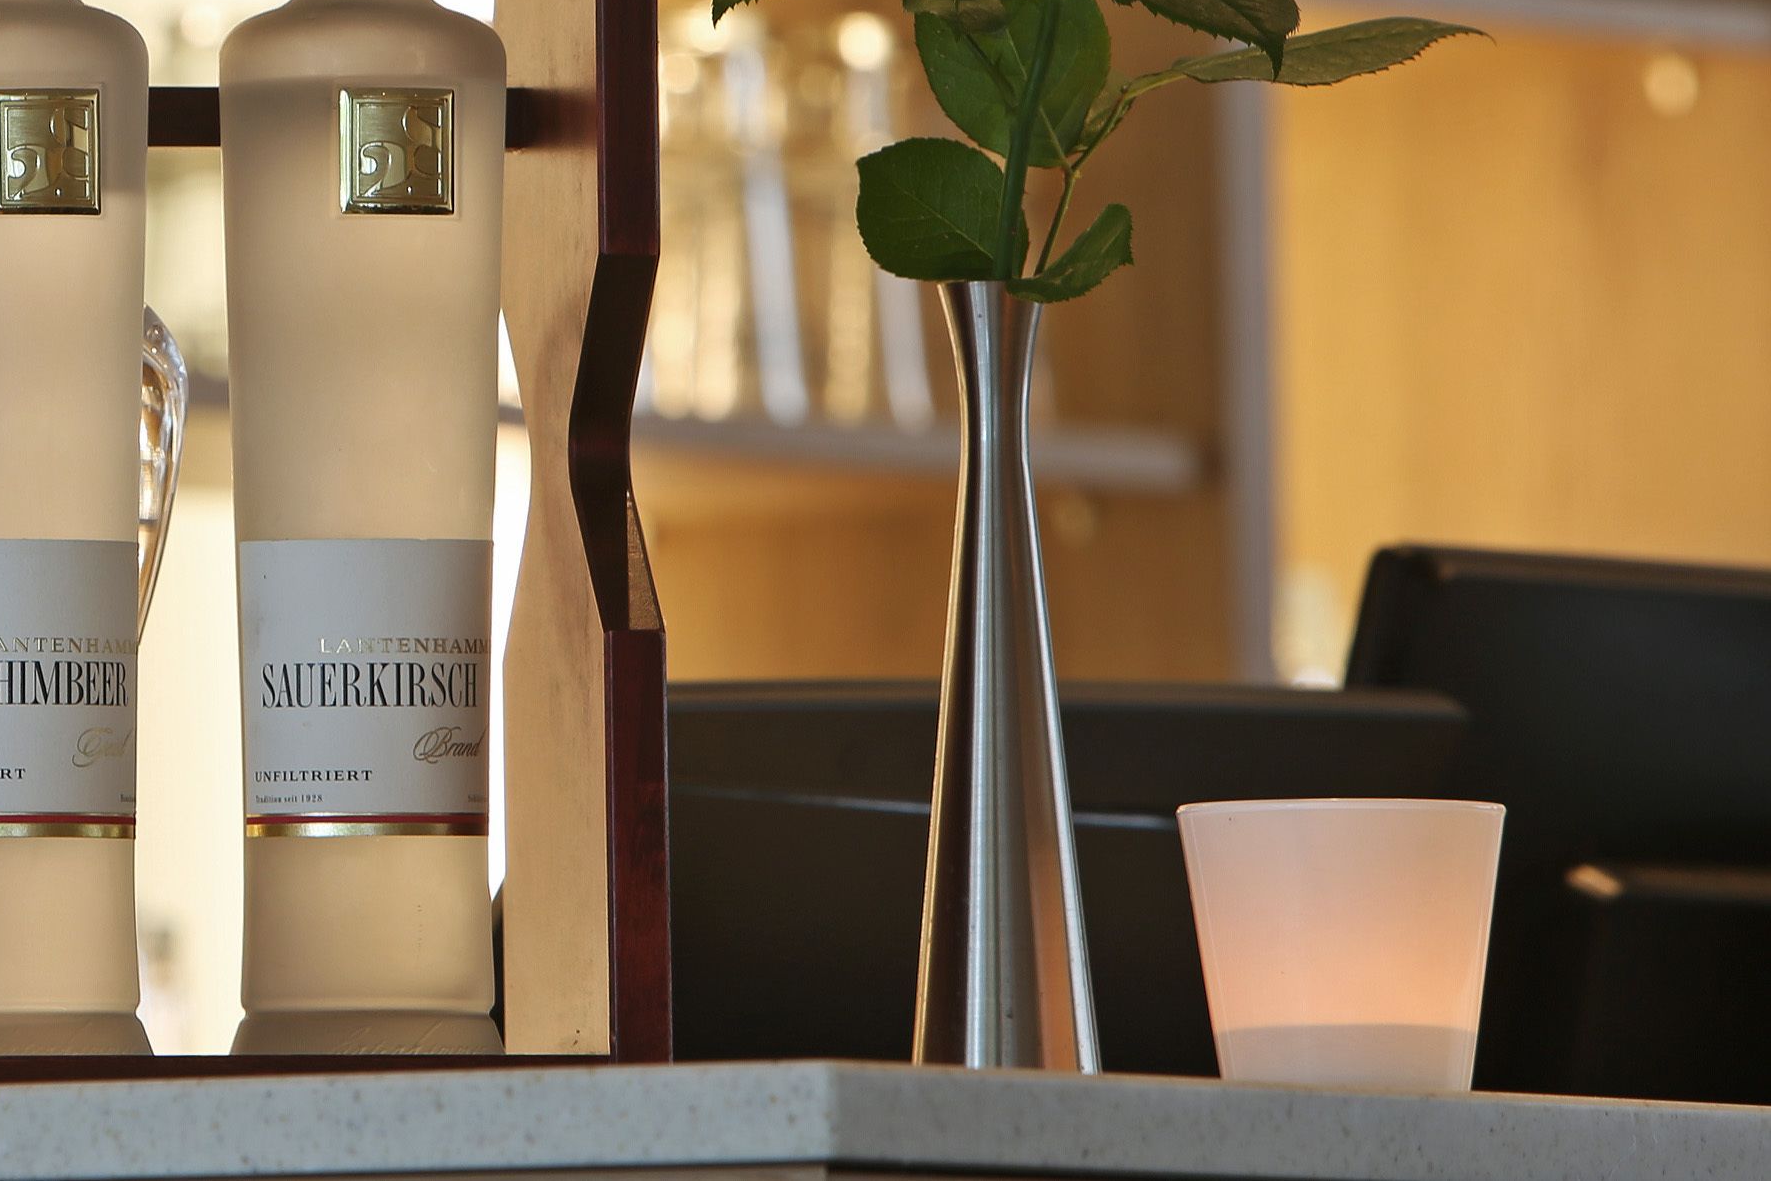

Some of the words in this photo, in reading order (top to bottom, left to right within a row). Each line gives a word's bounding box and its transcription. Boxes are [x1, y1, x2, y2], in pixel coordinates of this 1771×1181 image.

[261, 662, 478, 709] SAUERKIRSCH
[412, 726, 486, 764] Brand
[255, 770, 373, 783] UNFILTRIERT
[301, 794, 323, 804] 1928
